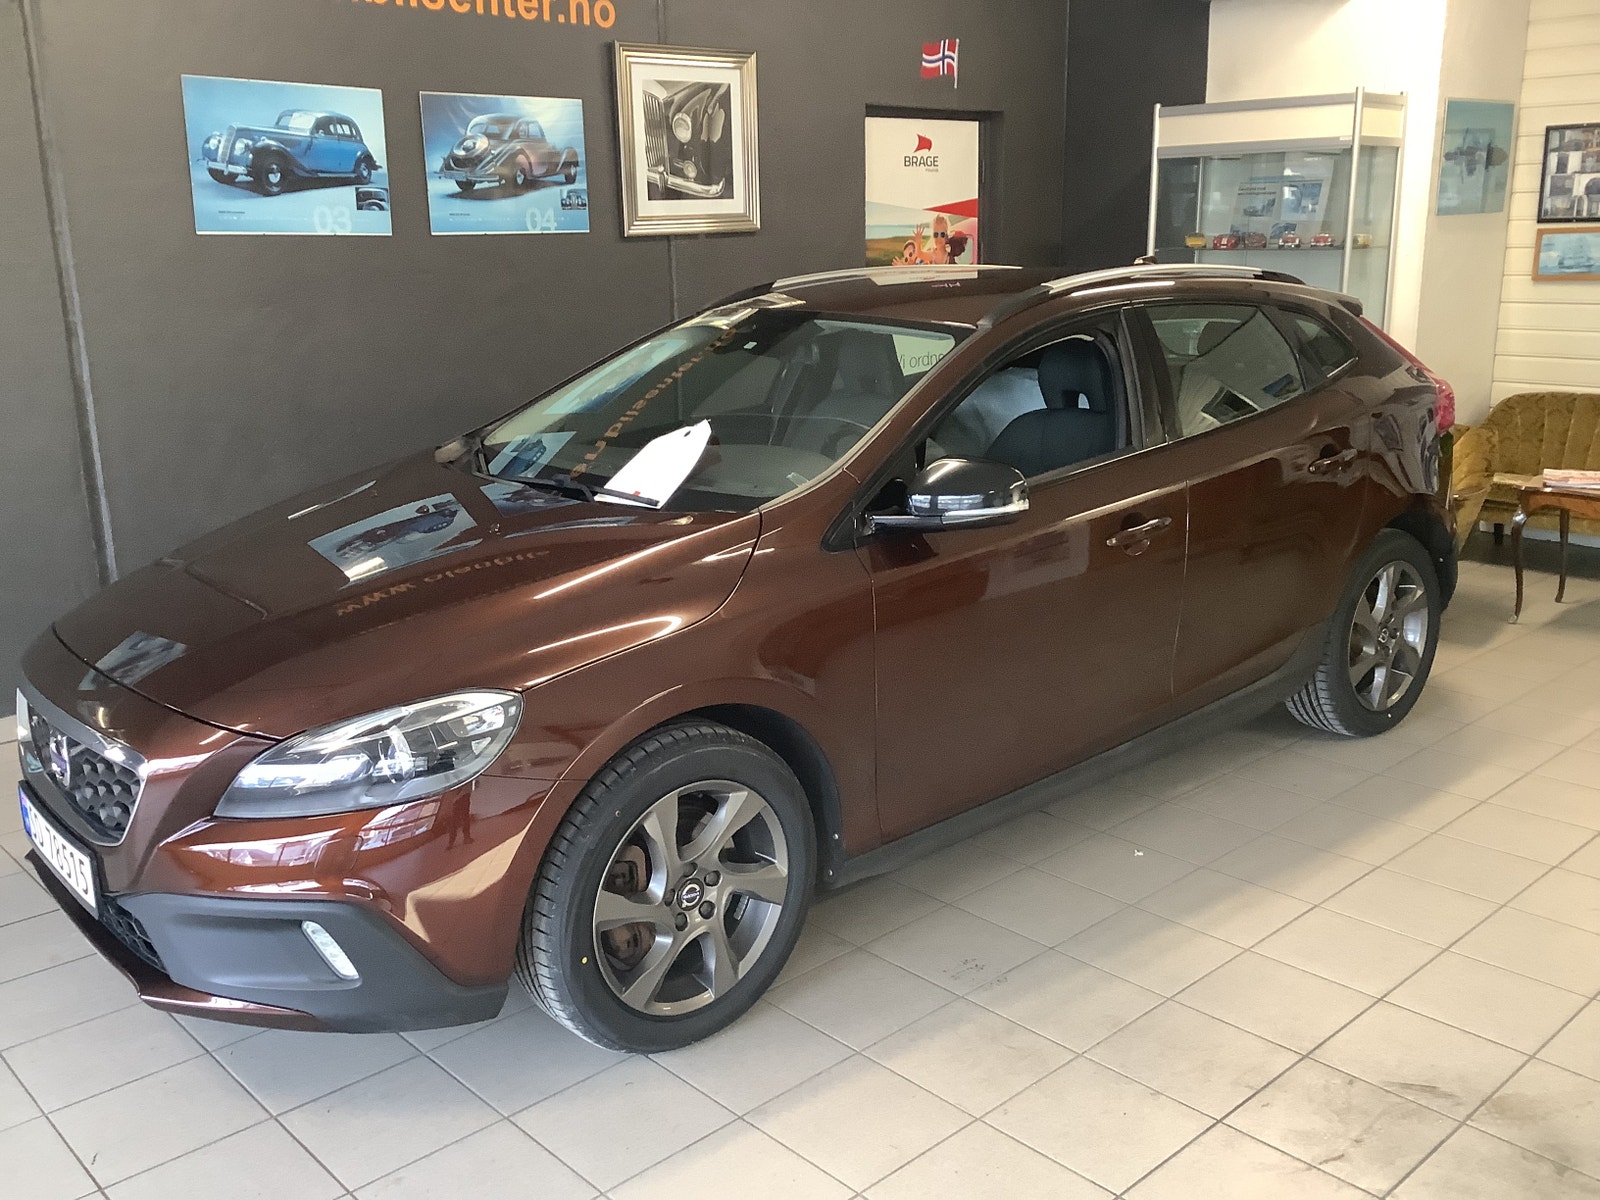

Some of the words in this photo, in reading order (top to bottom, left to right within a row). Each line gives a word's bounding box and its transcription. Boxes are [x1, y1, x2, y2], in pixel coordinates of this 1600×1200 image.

[904, 155, 939, 167] BRAGE
[313, 204, 352, 233] 03
[526, 207, 557, 231] 04
